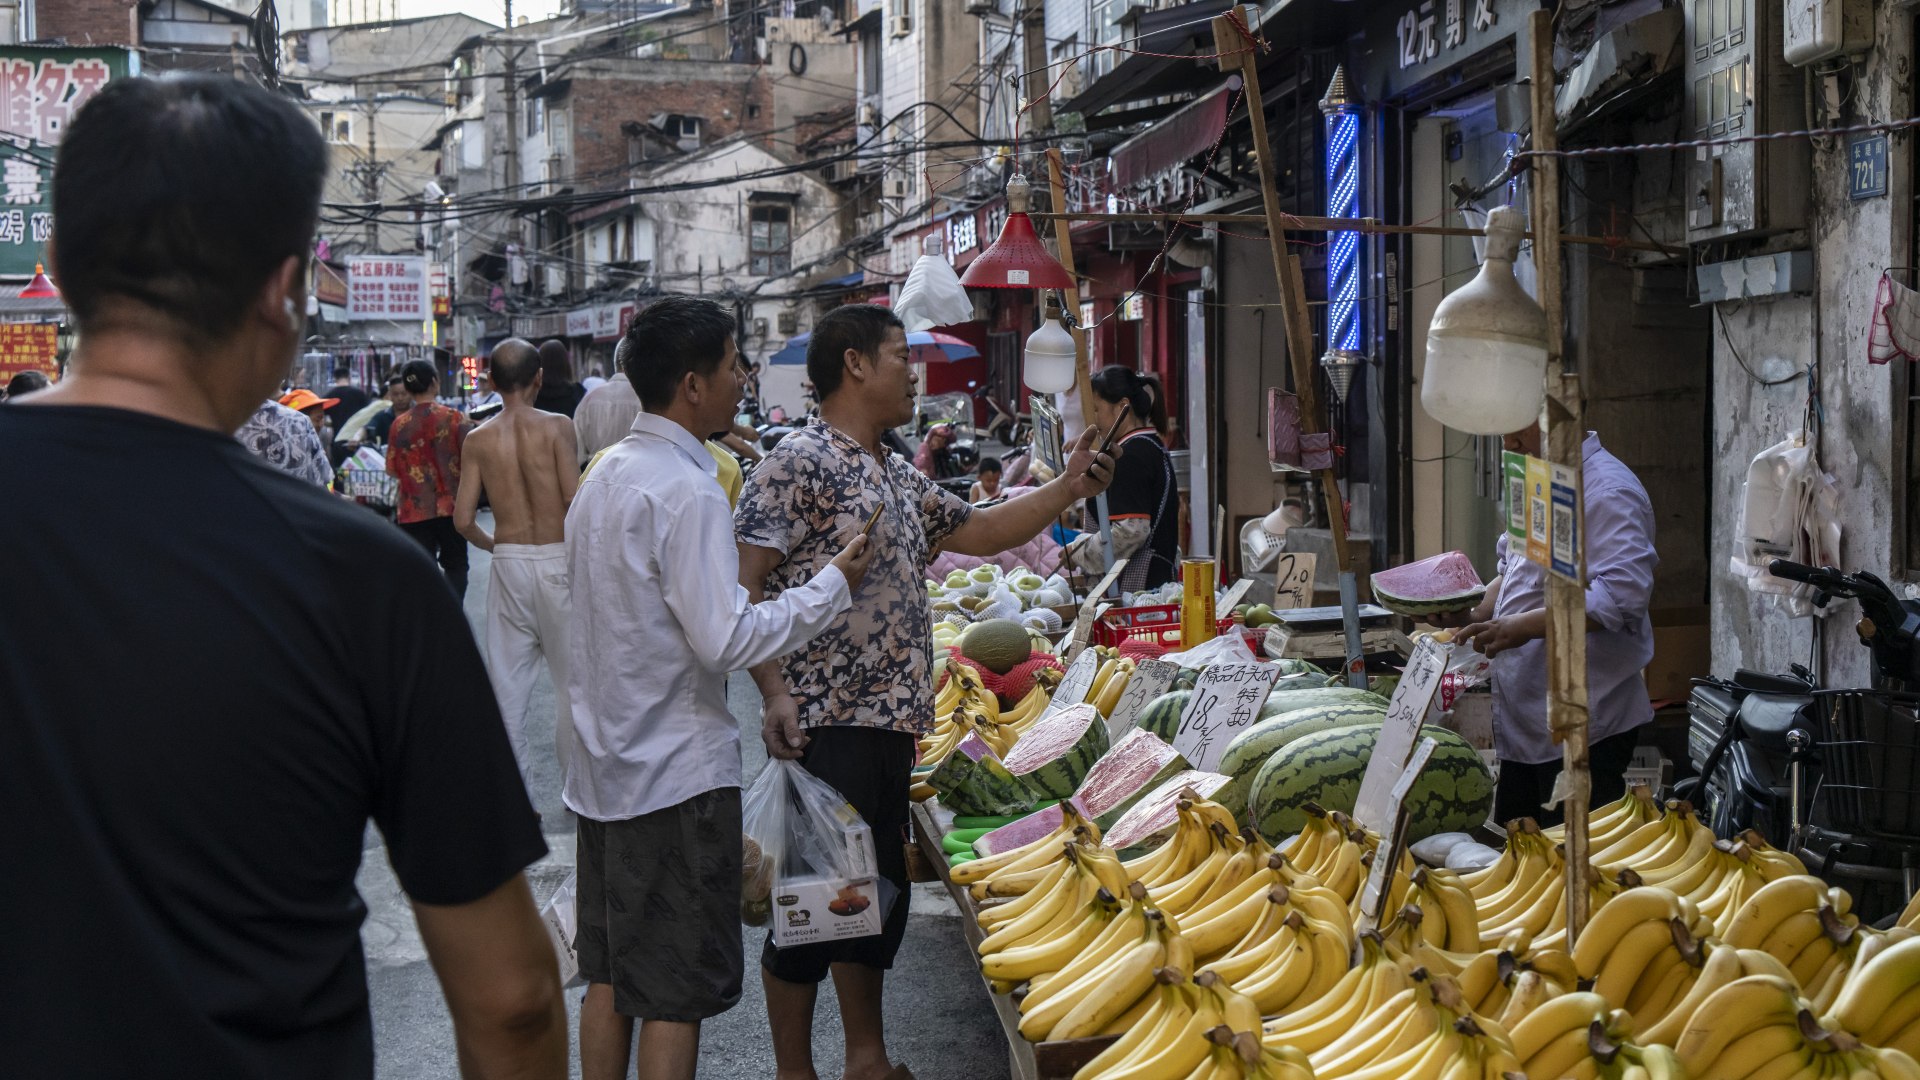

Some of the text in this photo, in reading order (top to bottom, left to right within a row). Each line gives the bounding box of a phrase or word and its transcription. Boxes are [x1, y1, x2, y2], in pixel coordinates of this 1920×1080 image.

[1855, 159, 1874, 190] 721
[352, 262, 405, 277] 社区服务站
[1200, 664, 1275, 687] 精品石头瓜
[1227, 687, 1260, 727] 特甜
